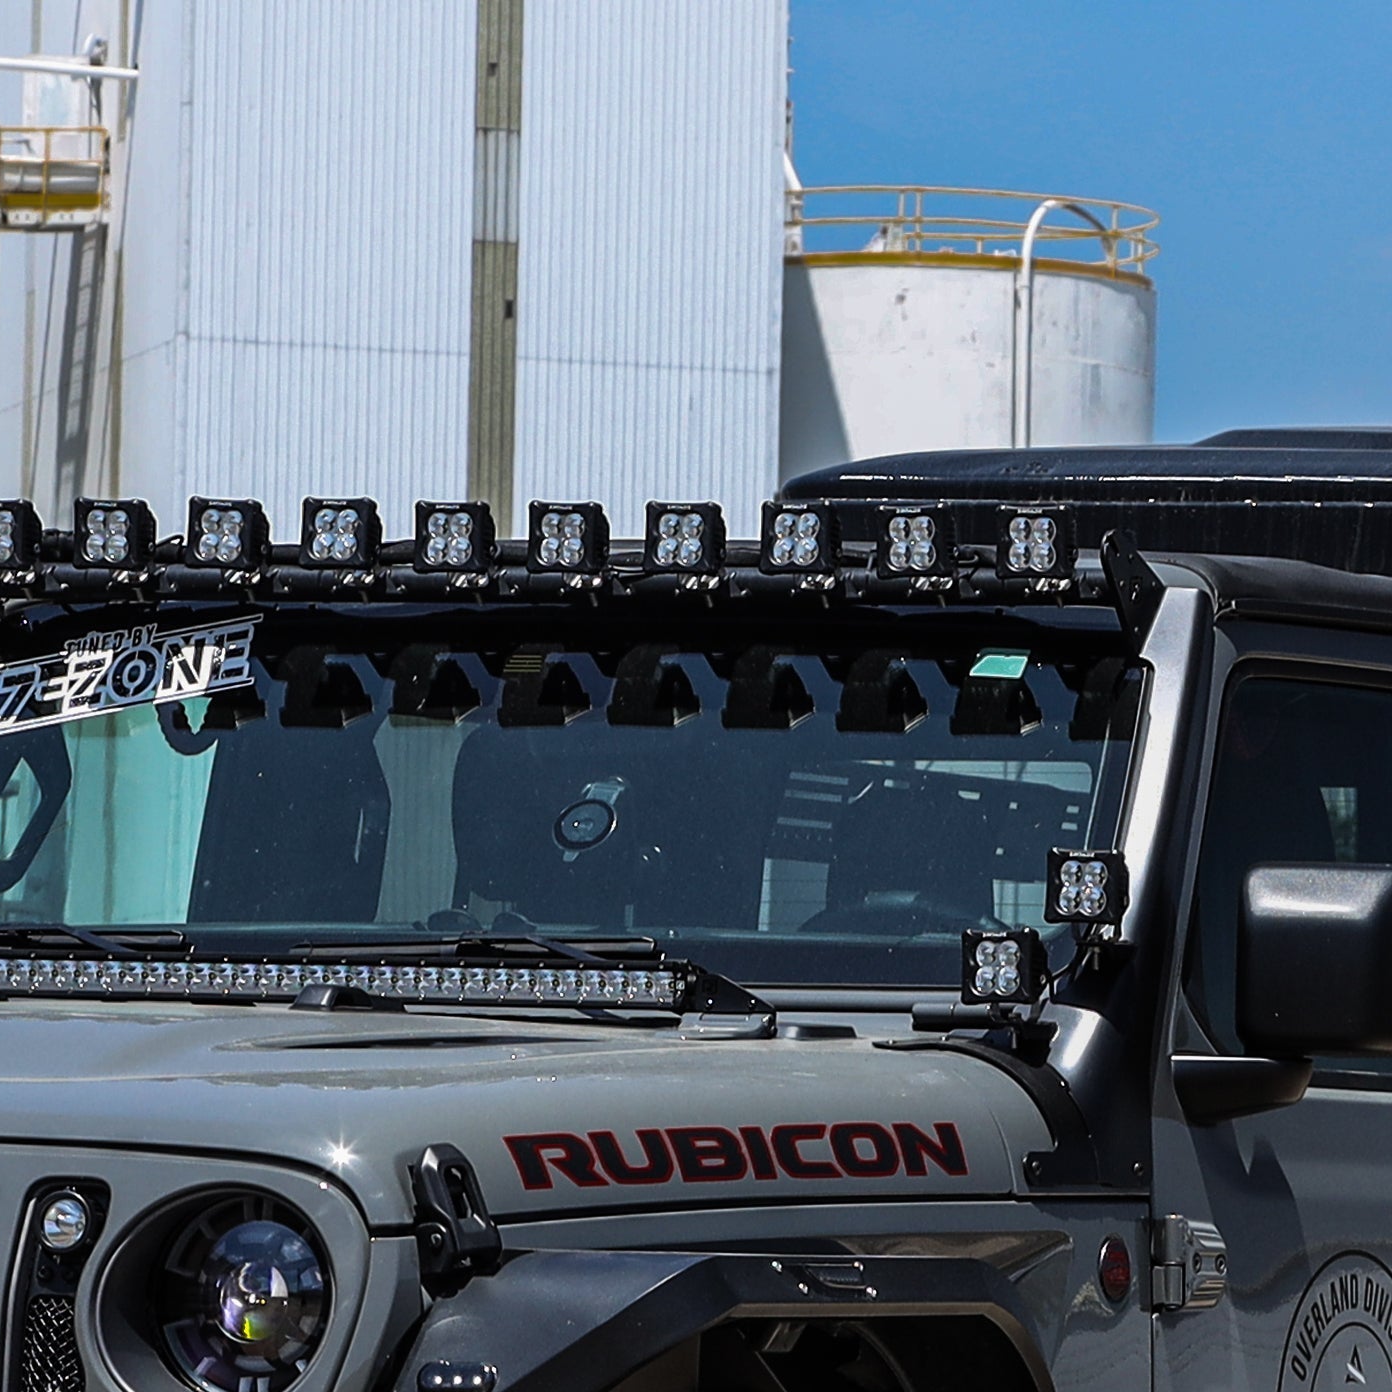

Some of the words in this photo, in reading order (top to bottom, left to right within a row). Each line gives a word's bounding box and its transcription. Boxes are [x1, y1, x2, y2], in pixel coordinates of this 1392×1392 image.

[63, 630, 124, 656] TUNED
[130, 623, 158, 648] BY
[501, 1120, 970, 1191] RUBICON
[1290, 1273, 1360, 1383] OVERLAND
